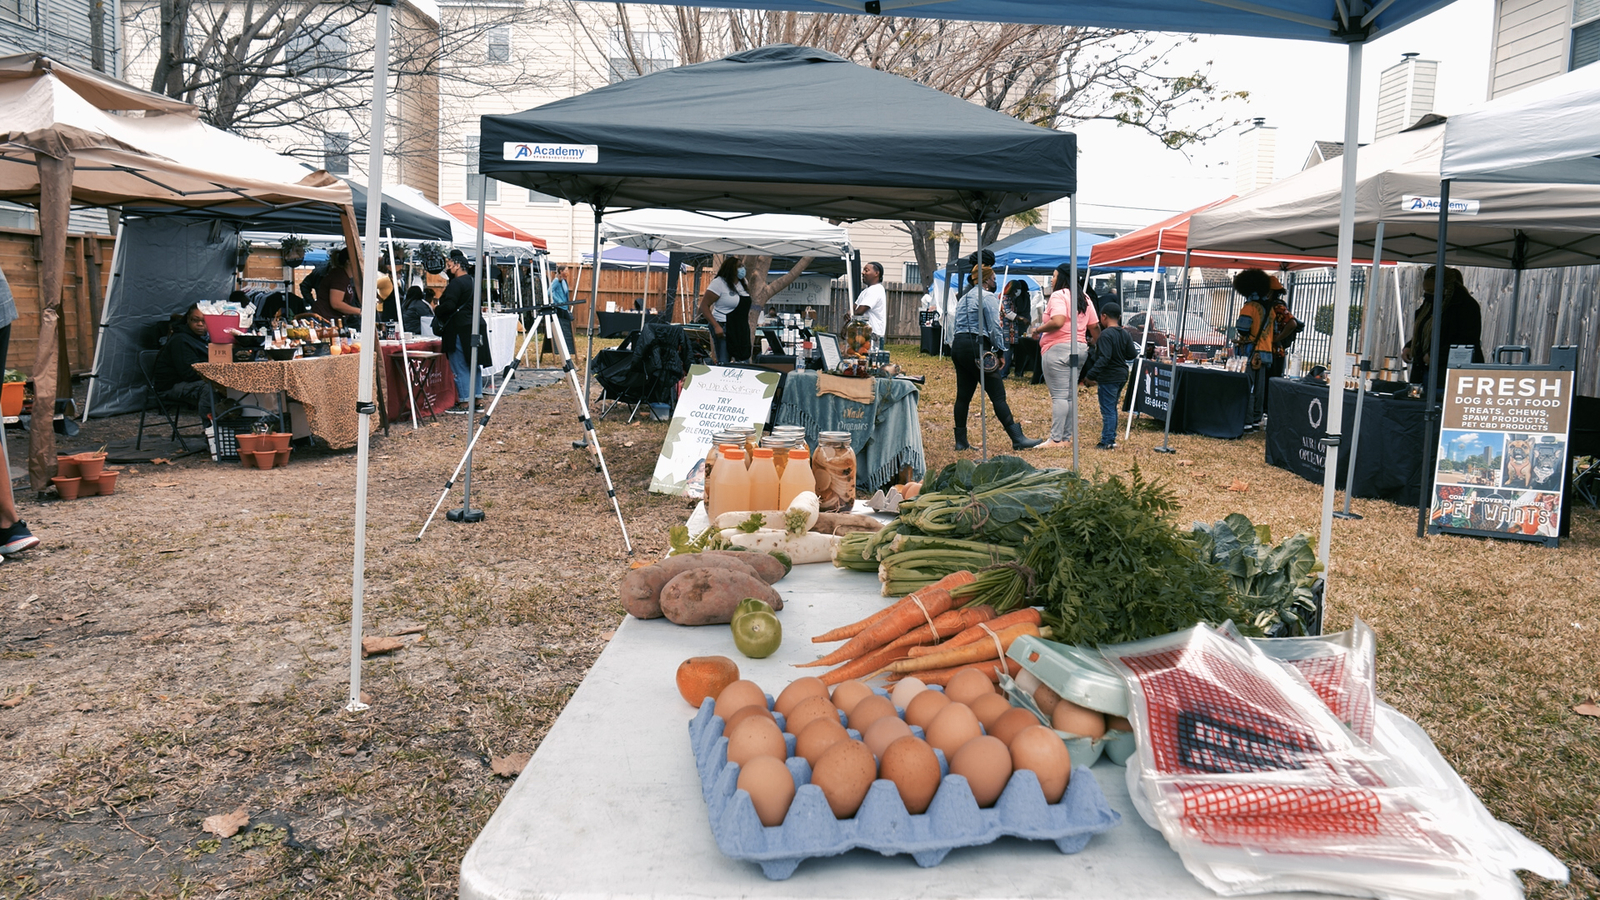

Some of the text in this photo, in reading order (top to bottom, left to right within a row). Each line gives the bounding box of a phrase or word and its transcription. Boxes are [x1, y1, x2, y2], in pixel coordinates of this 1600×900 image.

[533, 145, 585, 159] Academy
[1426, 200, 1469, 212] Acemy
[1457, 376, 1562, 398] FRESH
[717, 397, 732, 405] TRY
[1455, 396, 1561, 408] DOG & CAT FOOD
[699, 403, 746, 415] OUR HERBAL
[1463, 407, 1550, 418] TREATS, CHEWS,
[690, 410, 737, 422] COLLECTION
[699, 420, 734, 429] ORGANIC
[1500, 423, 1549, 431] PRODUCTS
[685, 426, 713, 436] BLENDS
[1469, 496, 1504, 504] DISCOVER
[1440, 501, 1550, 525] PET WANTS
